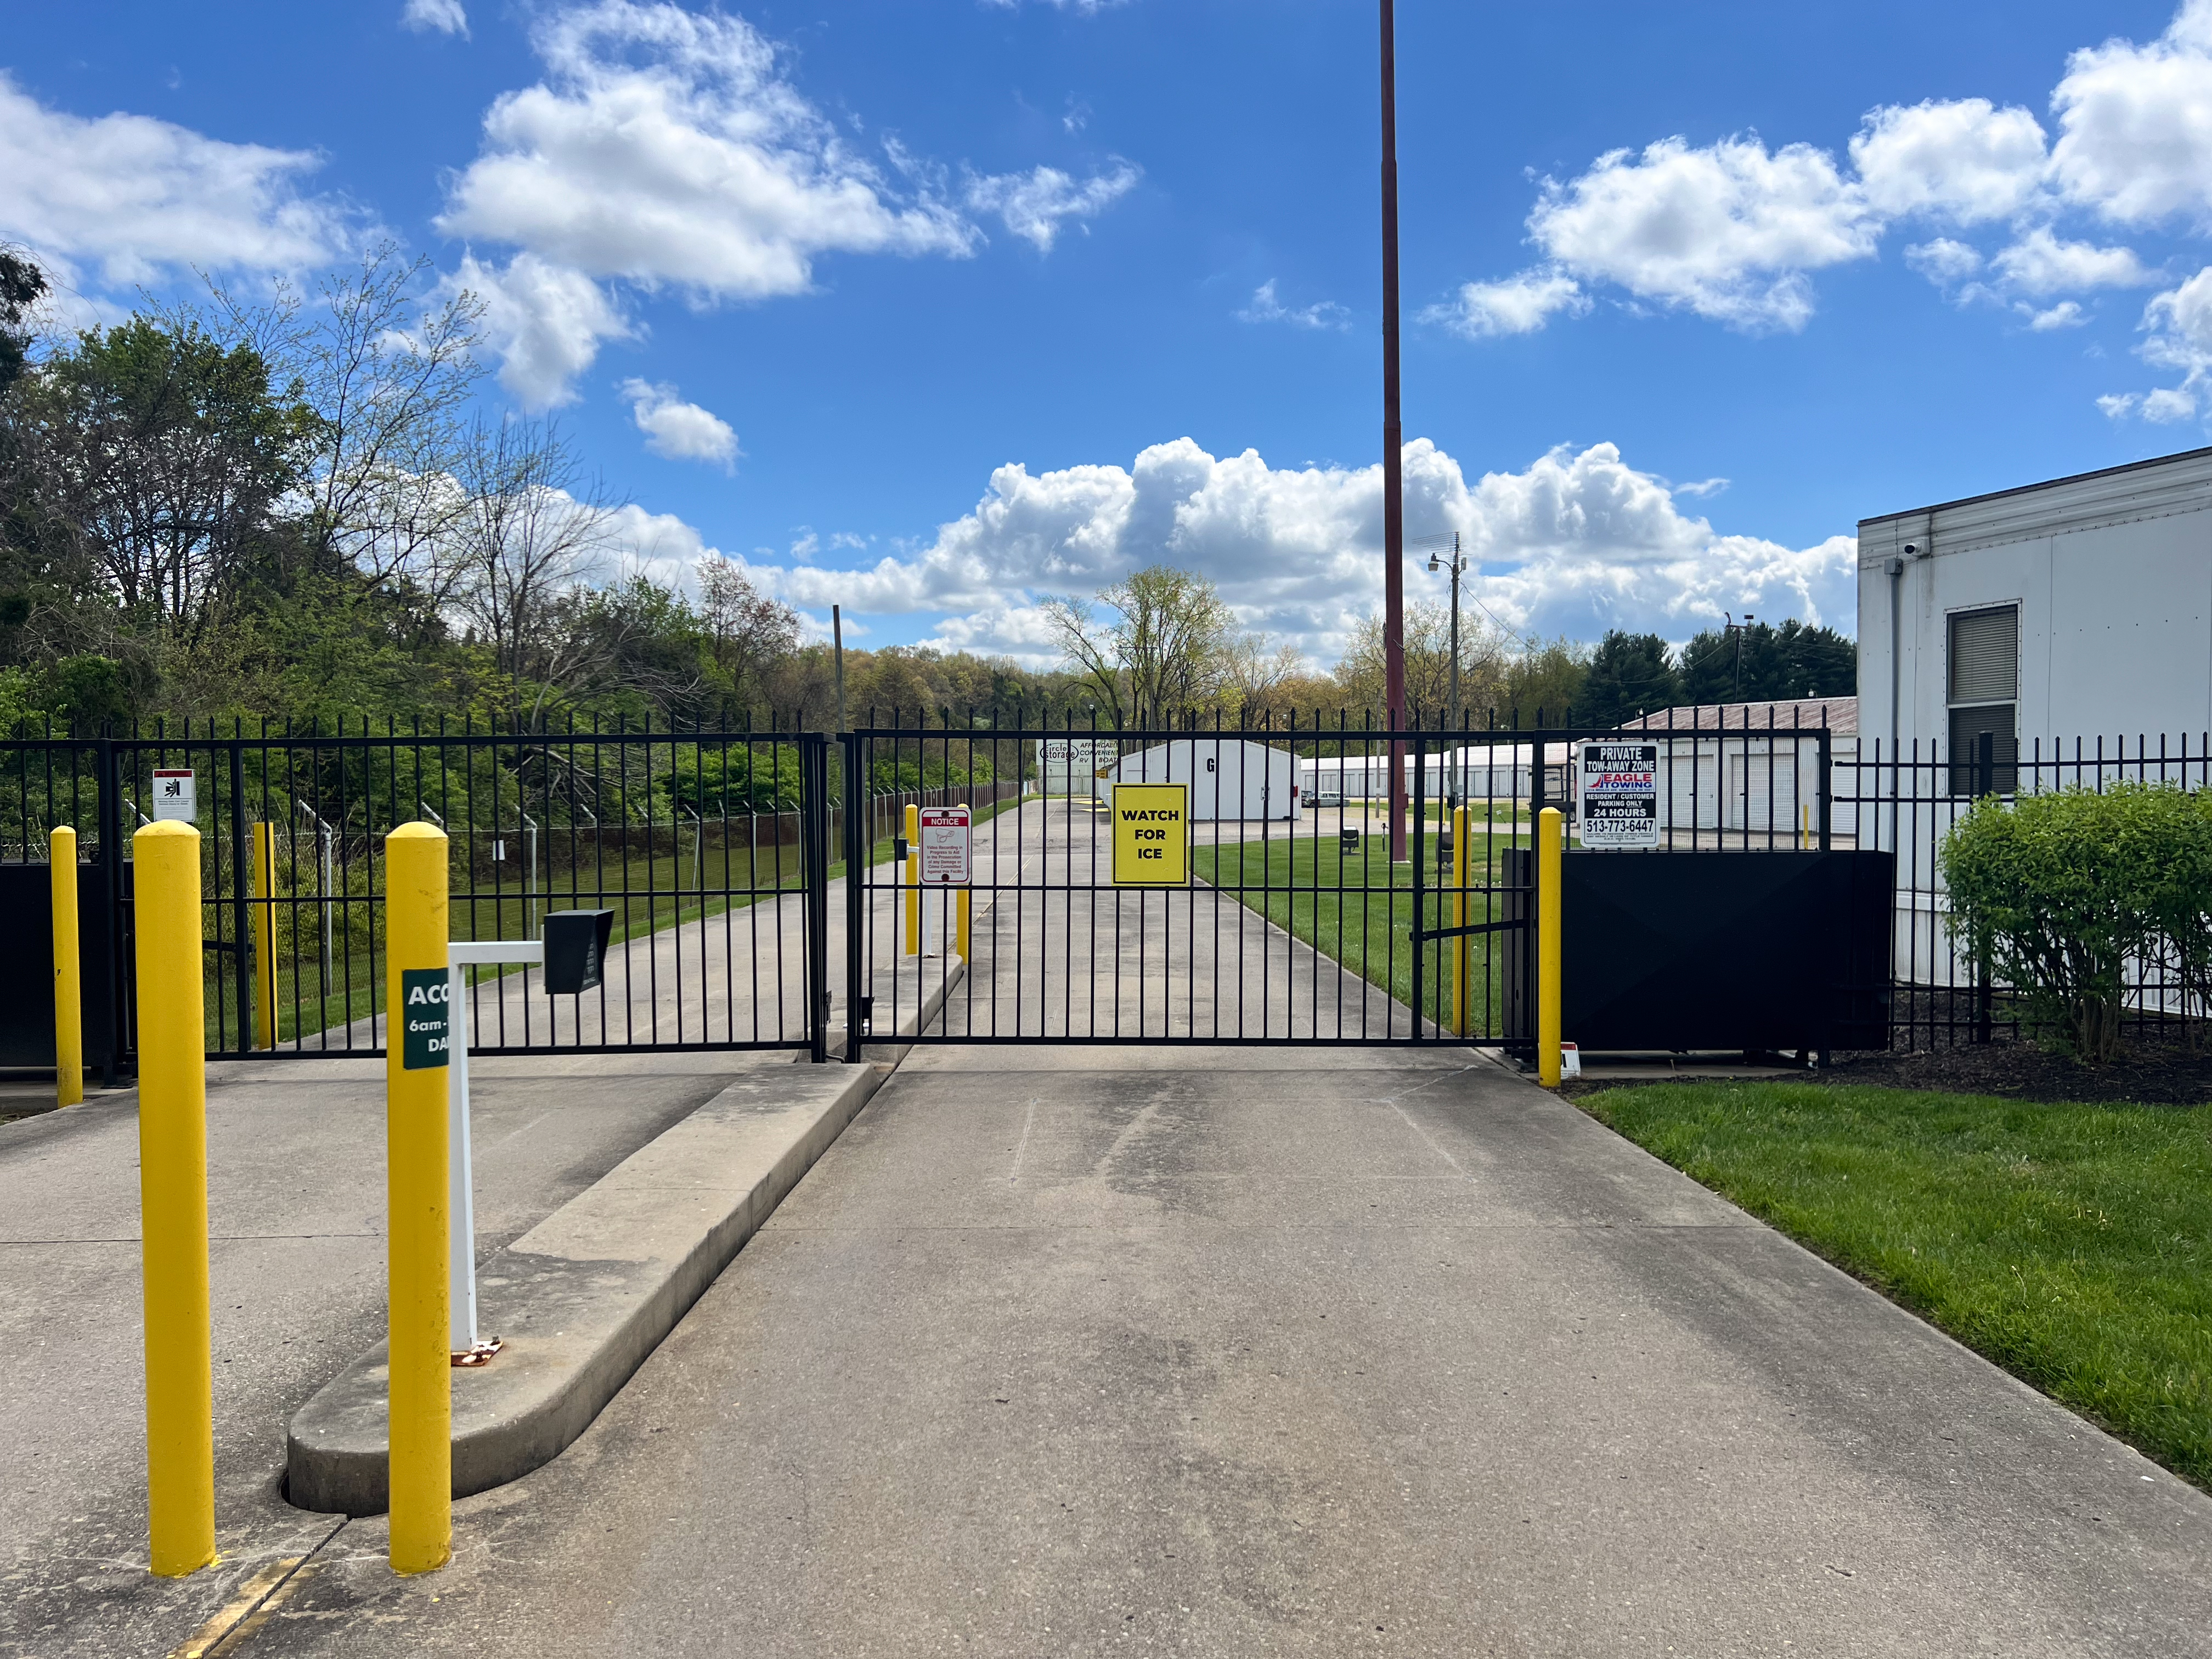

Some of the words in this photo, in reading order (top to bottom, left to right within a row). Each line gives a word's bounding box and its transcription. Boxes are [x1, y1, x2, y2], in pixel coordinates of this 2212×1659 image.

[1600, 747, 1642, 760] PRIVATE
[1206, 758, 1215, 772] G
[1587, 761, 1630, 771] TOW-AWAY
[1632, 761, 1654, 771] ZONE
[1604, 774, 1652, 782] EAGLE
[1121, 810, 1179, 821] WATCH
[1594, 809, 1606, 817] 24
[1610, 809, 1646, 817] HOURS
[1587, 820, 1654, 832] 513-773-6447
[1135, 830, 1166, 840] FOR
[1138, 849, 1163, 859] ICE
